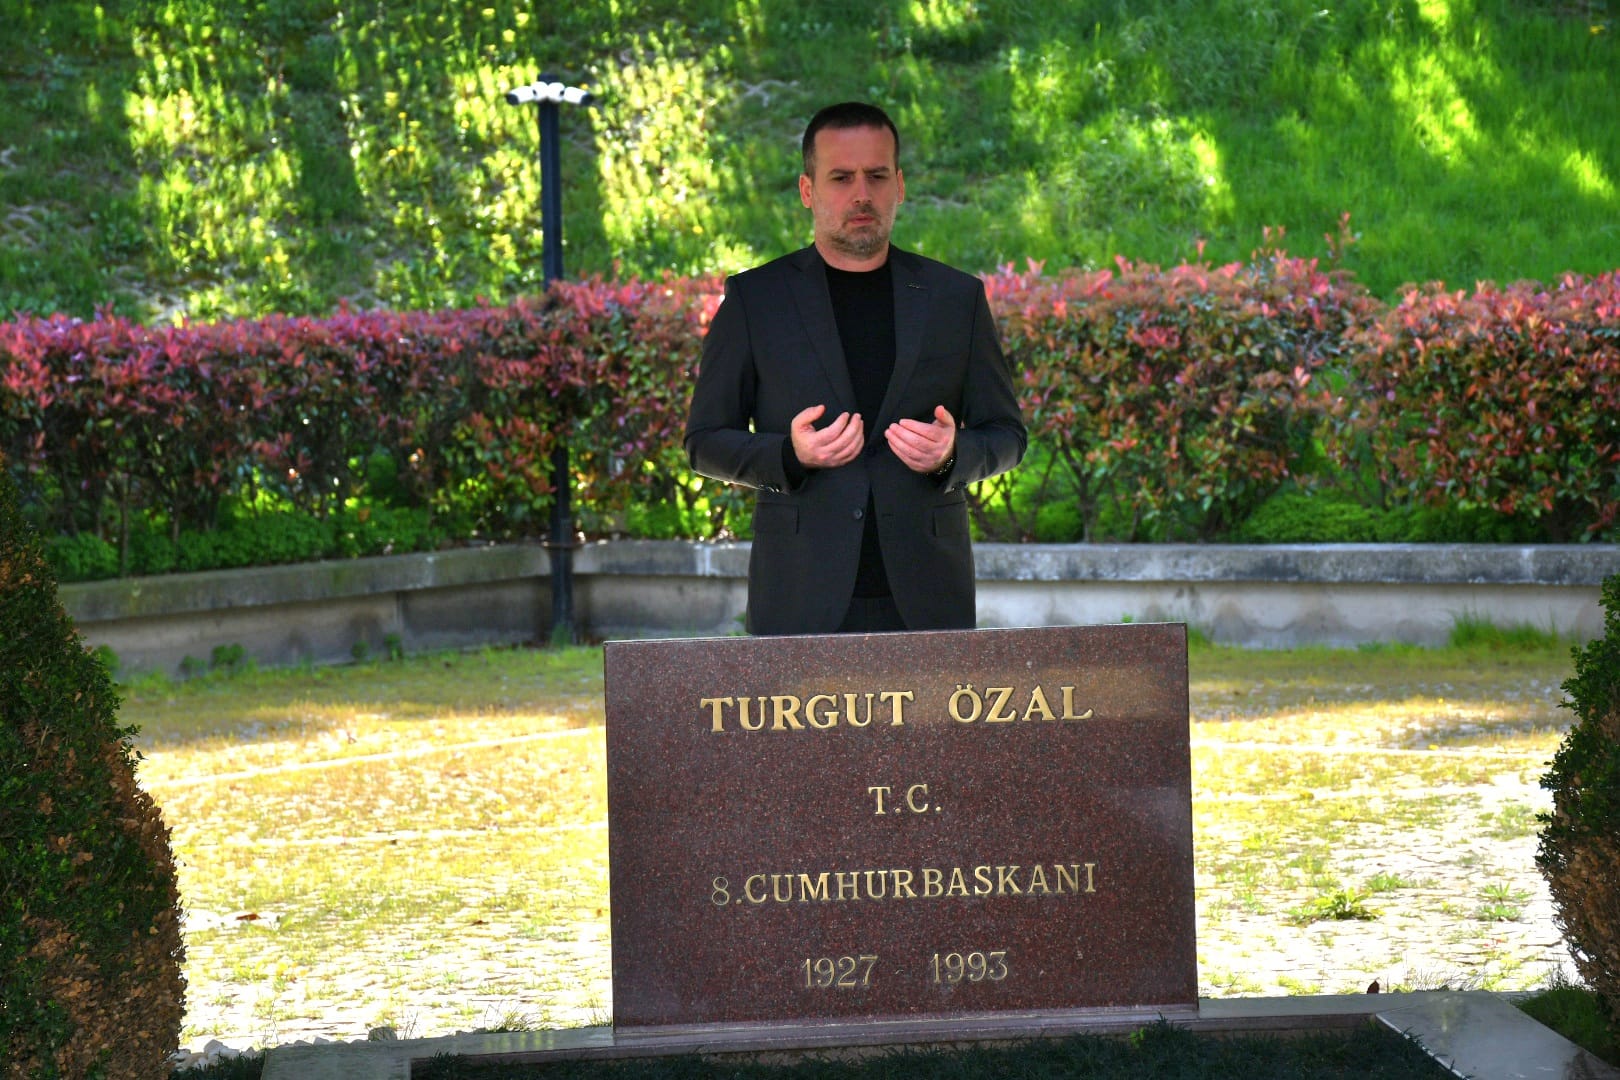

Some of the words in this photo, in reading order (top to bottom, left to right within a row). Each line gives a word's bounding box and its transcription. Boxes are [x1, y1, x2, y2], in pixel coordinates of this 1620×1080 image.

[700, 691, 914, 732] TURGUT
[948, 683, 1094, 724] ÖZAL
[868, 784, 943, 815] T.C.
[801, 955, 878, 988] 1927
[930, 951, 1008, 984] 1993
